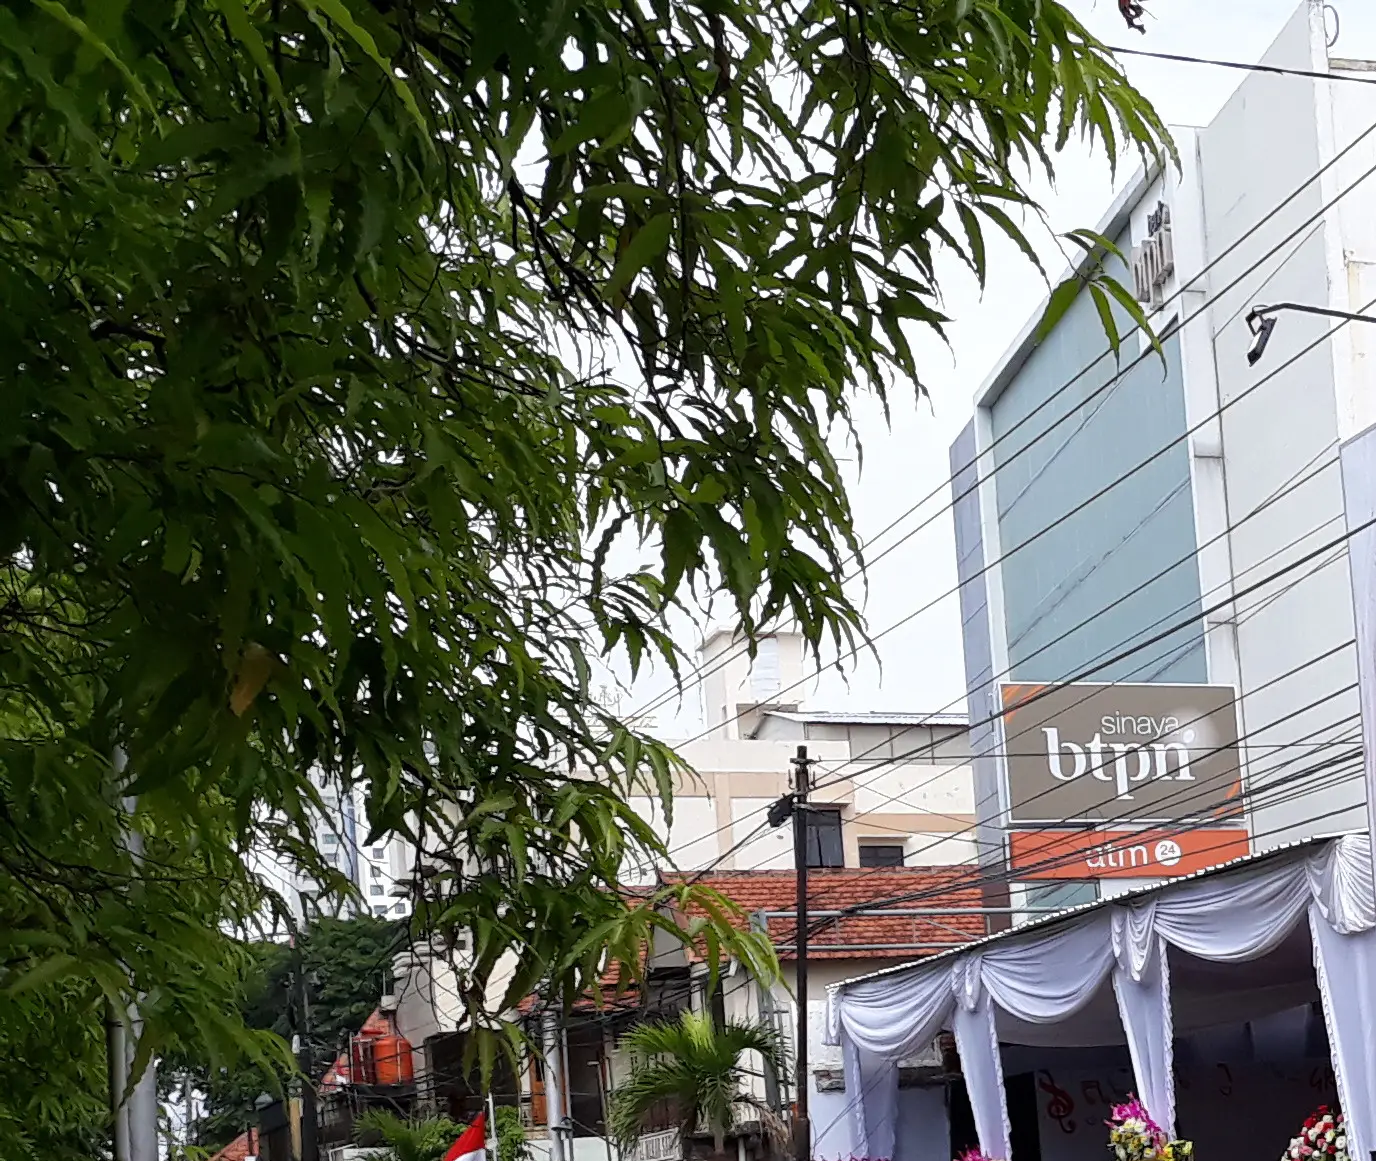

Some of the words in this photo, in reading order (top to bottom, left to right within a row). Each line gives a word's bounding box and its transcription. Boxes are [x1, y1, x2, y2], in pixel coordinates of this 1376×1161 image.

[1101, 711, 1180, 738] sinaya
[1041, 728, 1196, 800] btpn
[1085, 842, 1148, 869] atm
[1159, 845, 1176, 857] 24
